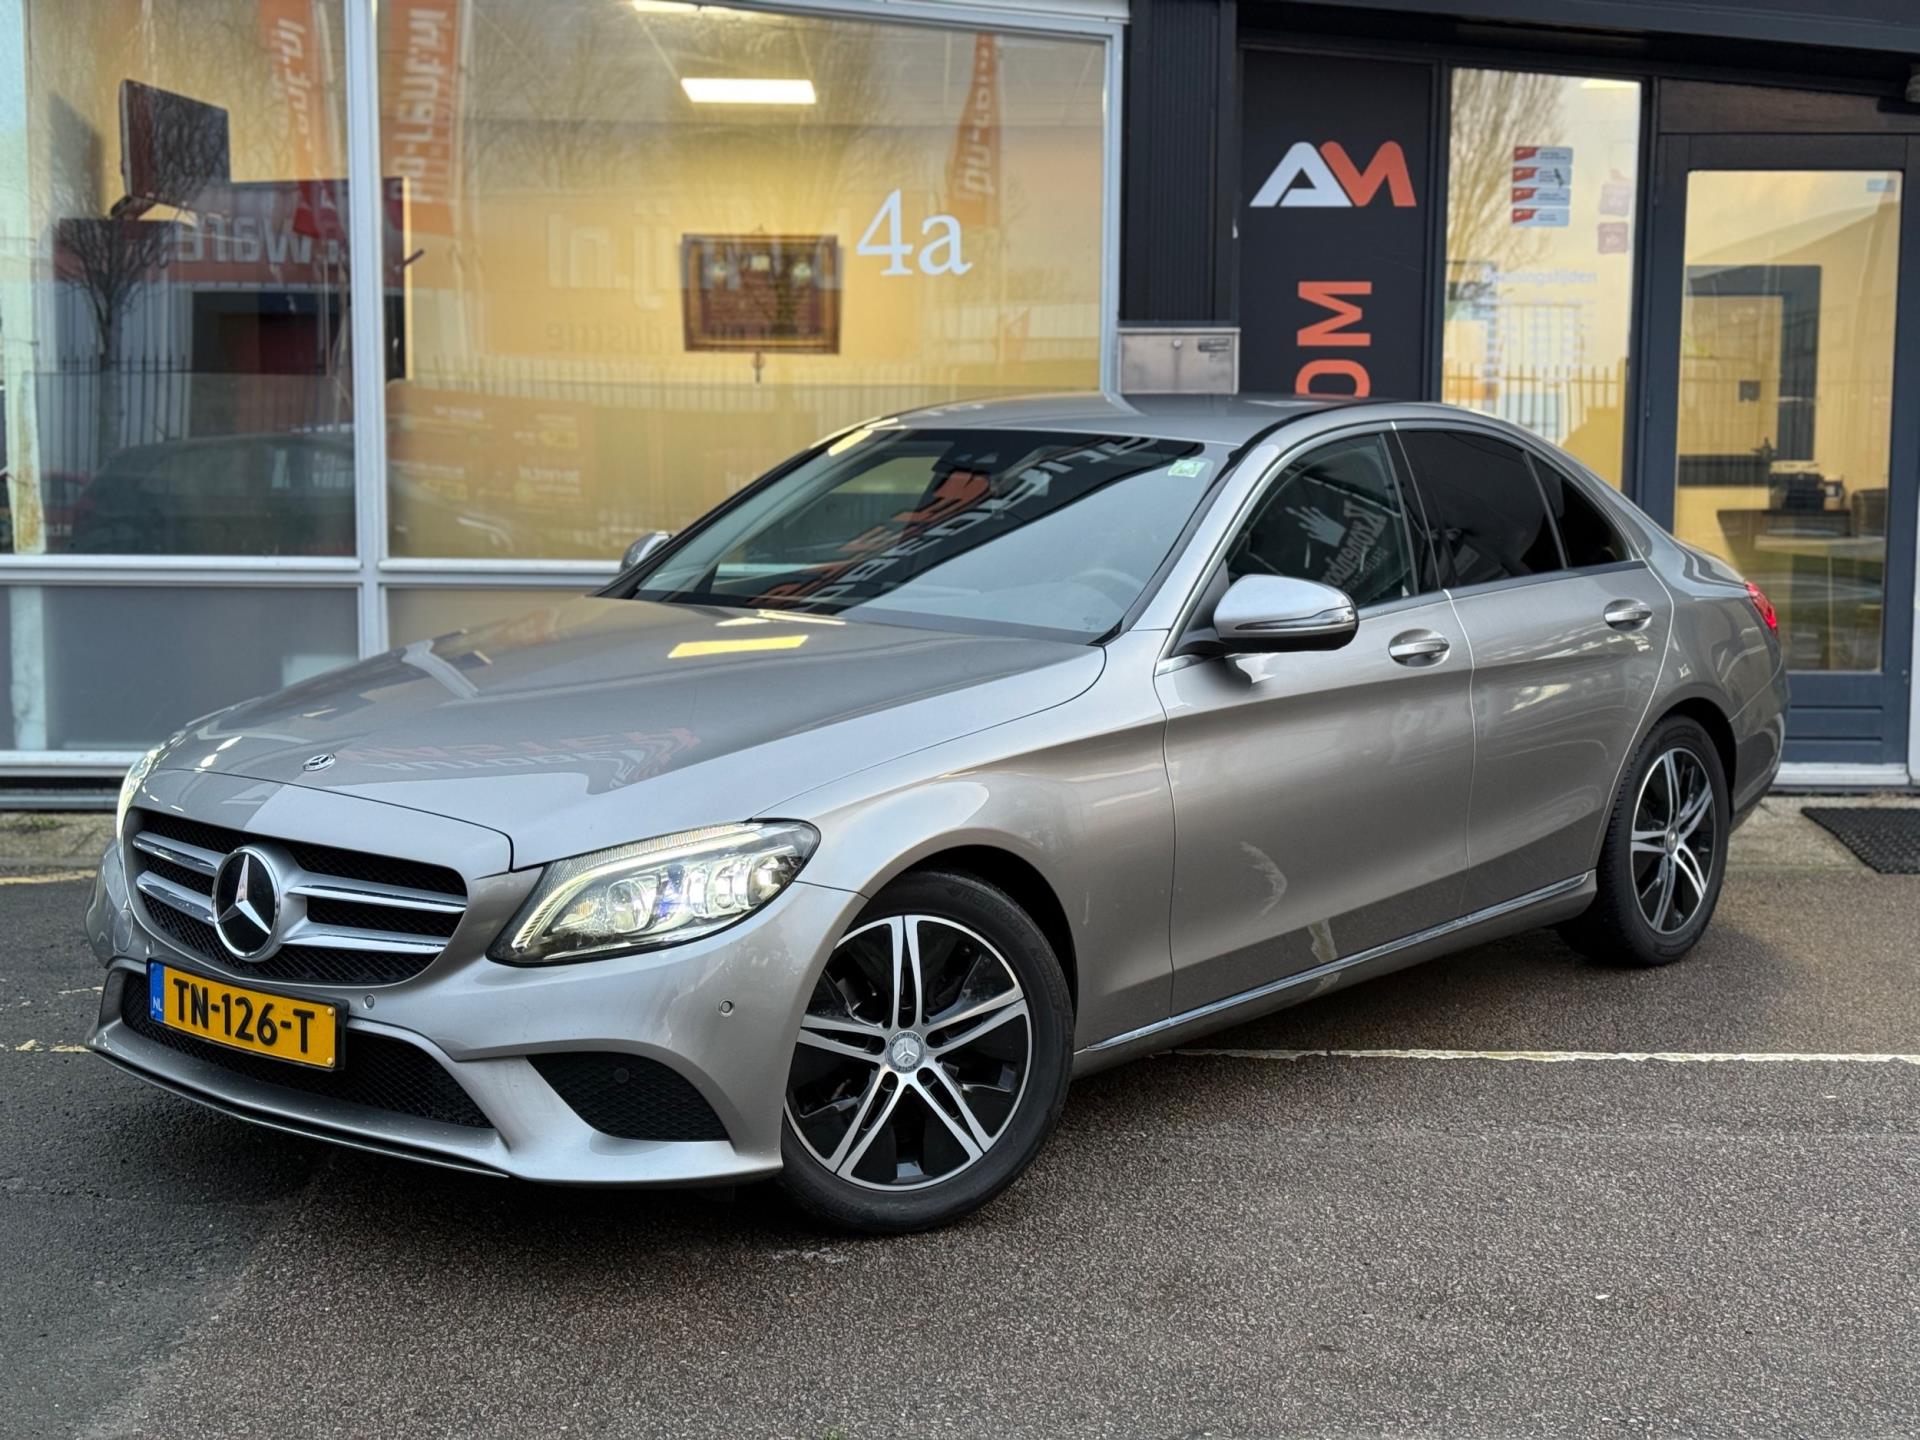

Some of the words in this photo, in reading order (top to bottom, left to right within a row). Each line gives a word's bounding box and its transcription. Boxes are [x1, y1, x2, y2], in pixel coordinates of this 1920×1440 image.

[856, 189, 973, 276] 4a
[152, 997, 163, 1012] NL
[173, 977, 315, 1054] TN-126-T
